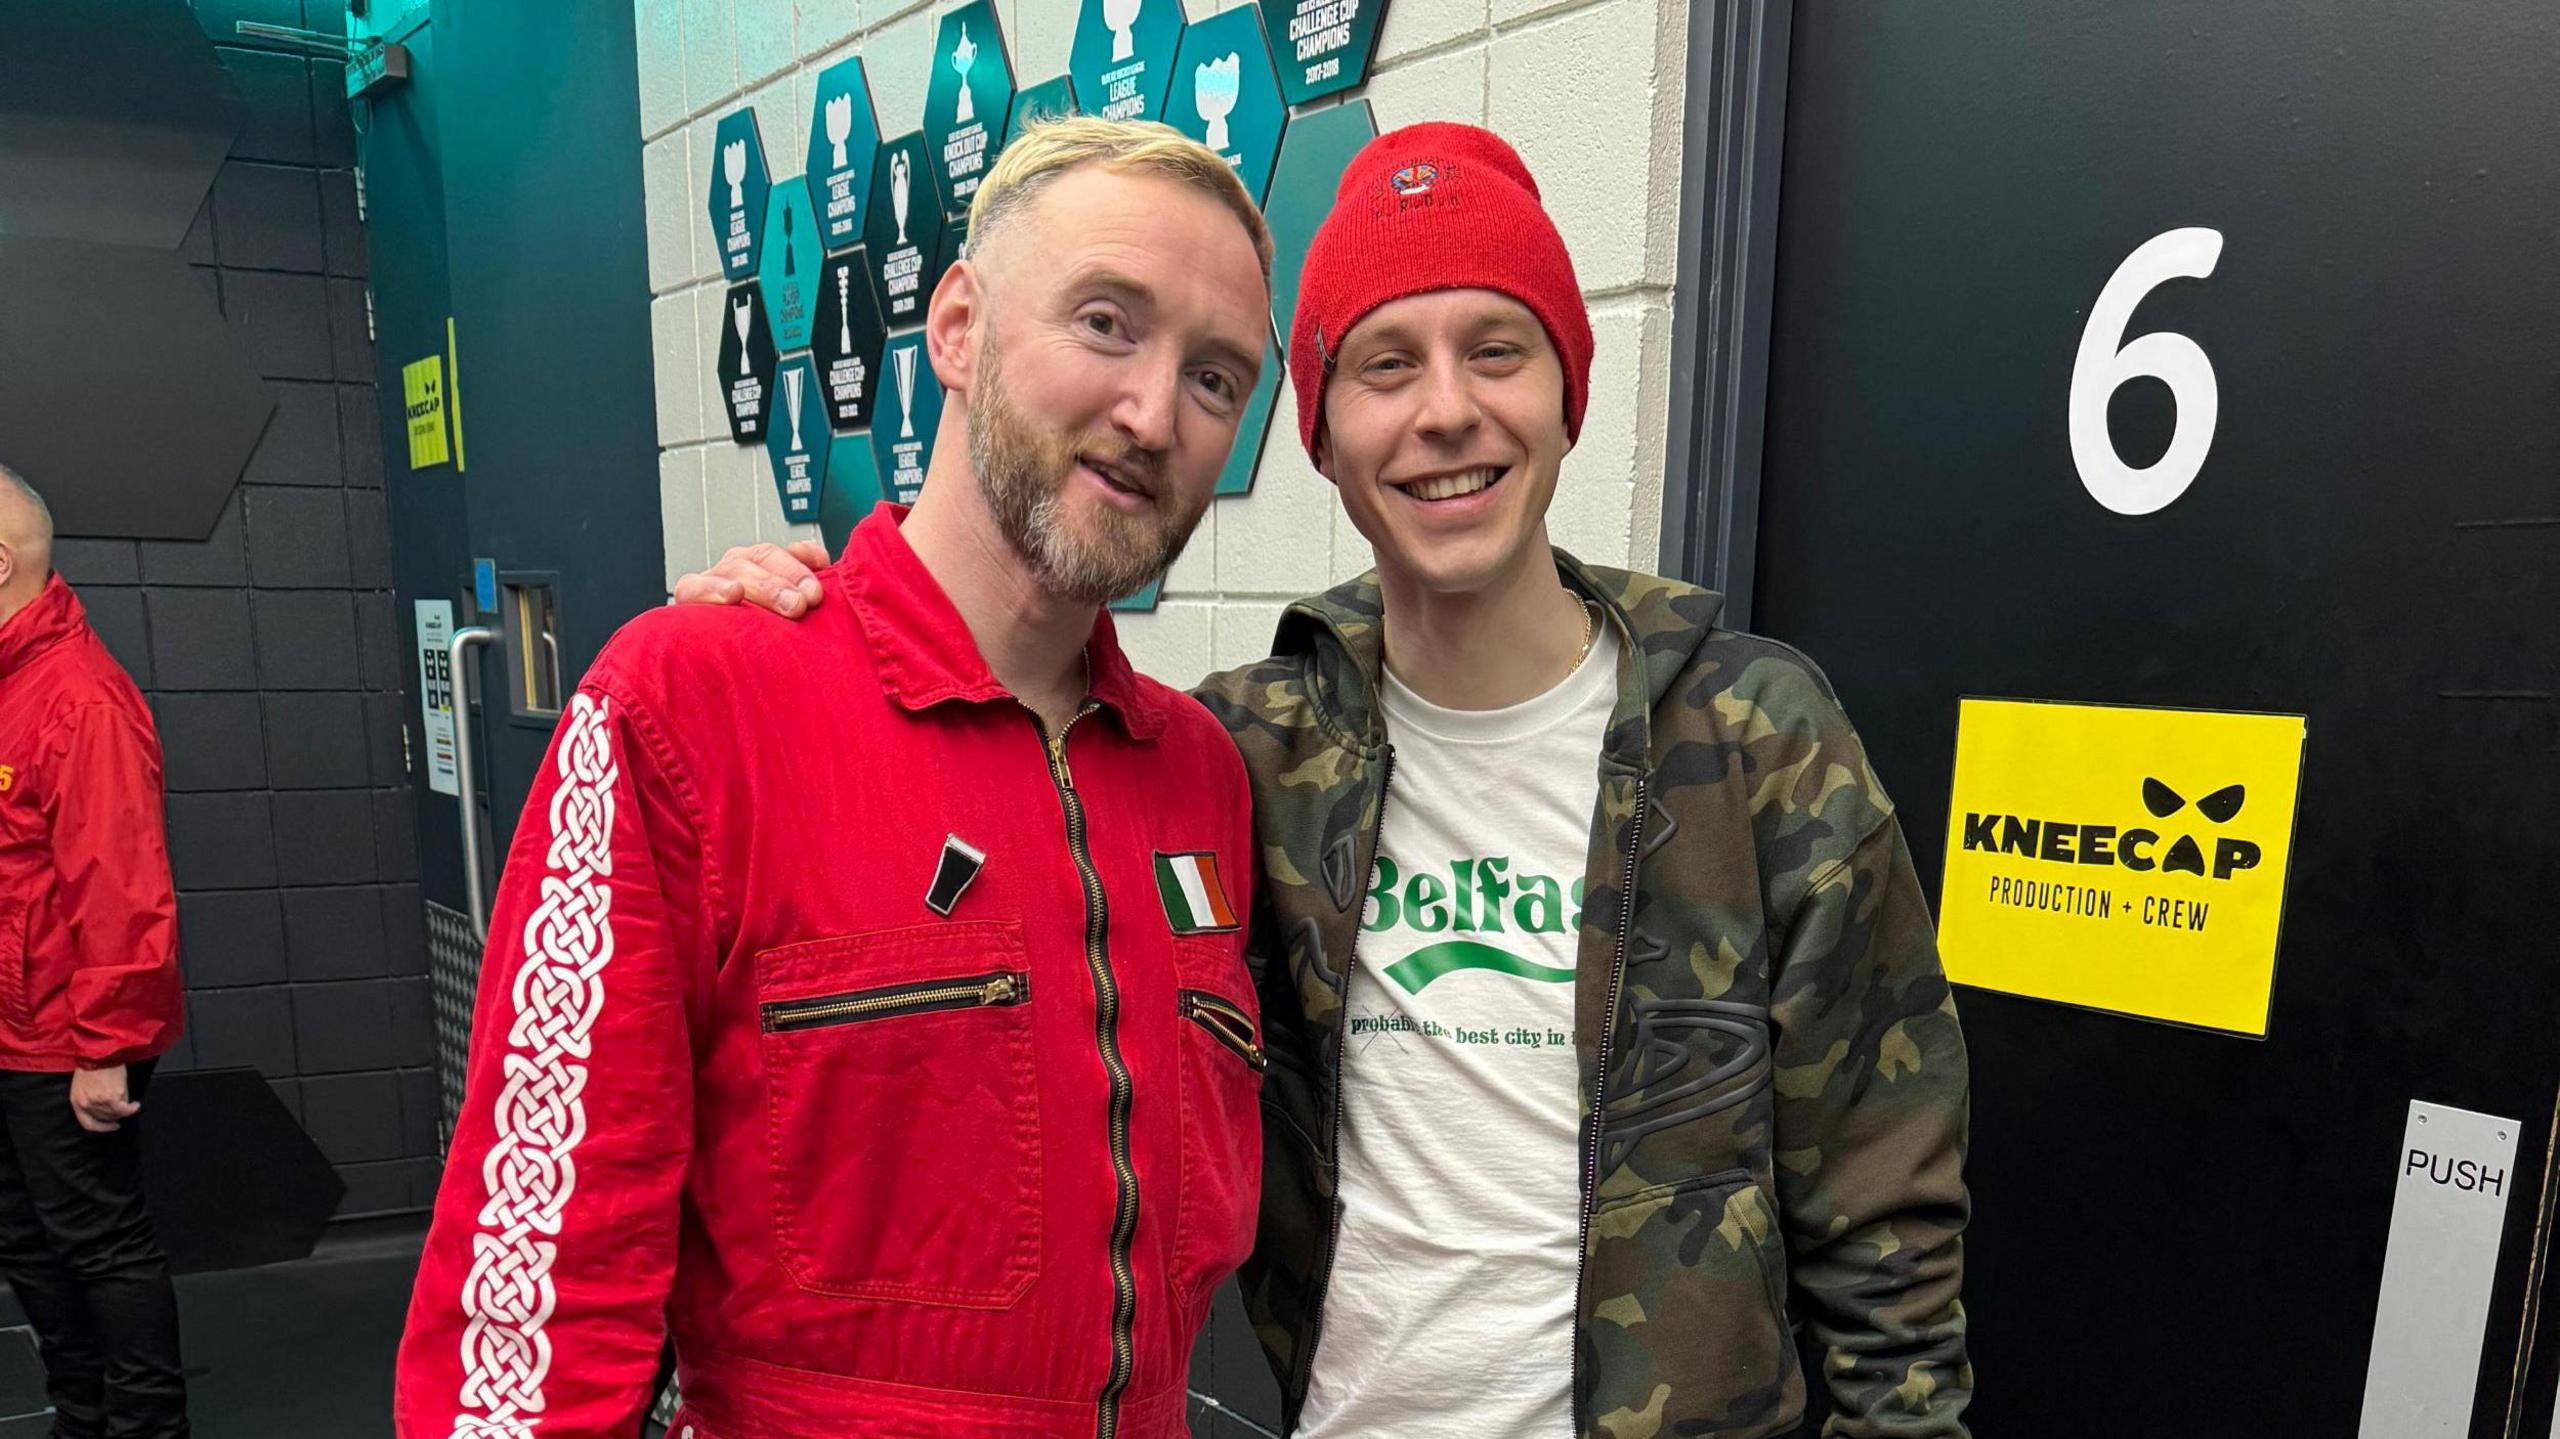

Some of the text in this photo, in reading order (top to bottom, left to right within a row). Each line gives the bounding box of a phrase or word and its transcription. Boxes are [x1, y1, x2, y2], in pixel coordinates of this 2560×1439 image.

[1290, 0, 1359, 41] CHALLENGE CUP
[1297, 22, 1351, 61] CHAMPIONS
[1103, 94, 1144, 121] CHAMPIONS
[1110, 75, 1137, 103] LEAGUE
[949, 151, 984, 178] CHAMPIONS
[2068, 226, 2223, 516] 6
[1963, 813, 2262, 880] KNEECAP
[1989, 876, 2111, 918] PRODUCTION
[2143, 896, 2209, 931] CREW
[1456, 1027, 1499, 1045] best
[1505, 1028, 1541, 1048] city
[1547, 1028, 1565, 1046] in
[2405, 1149, 2504, 1197] PUSH
